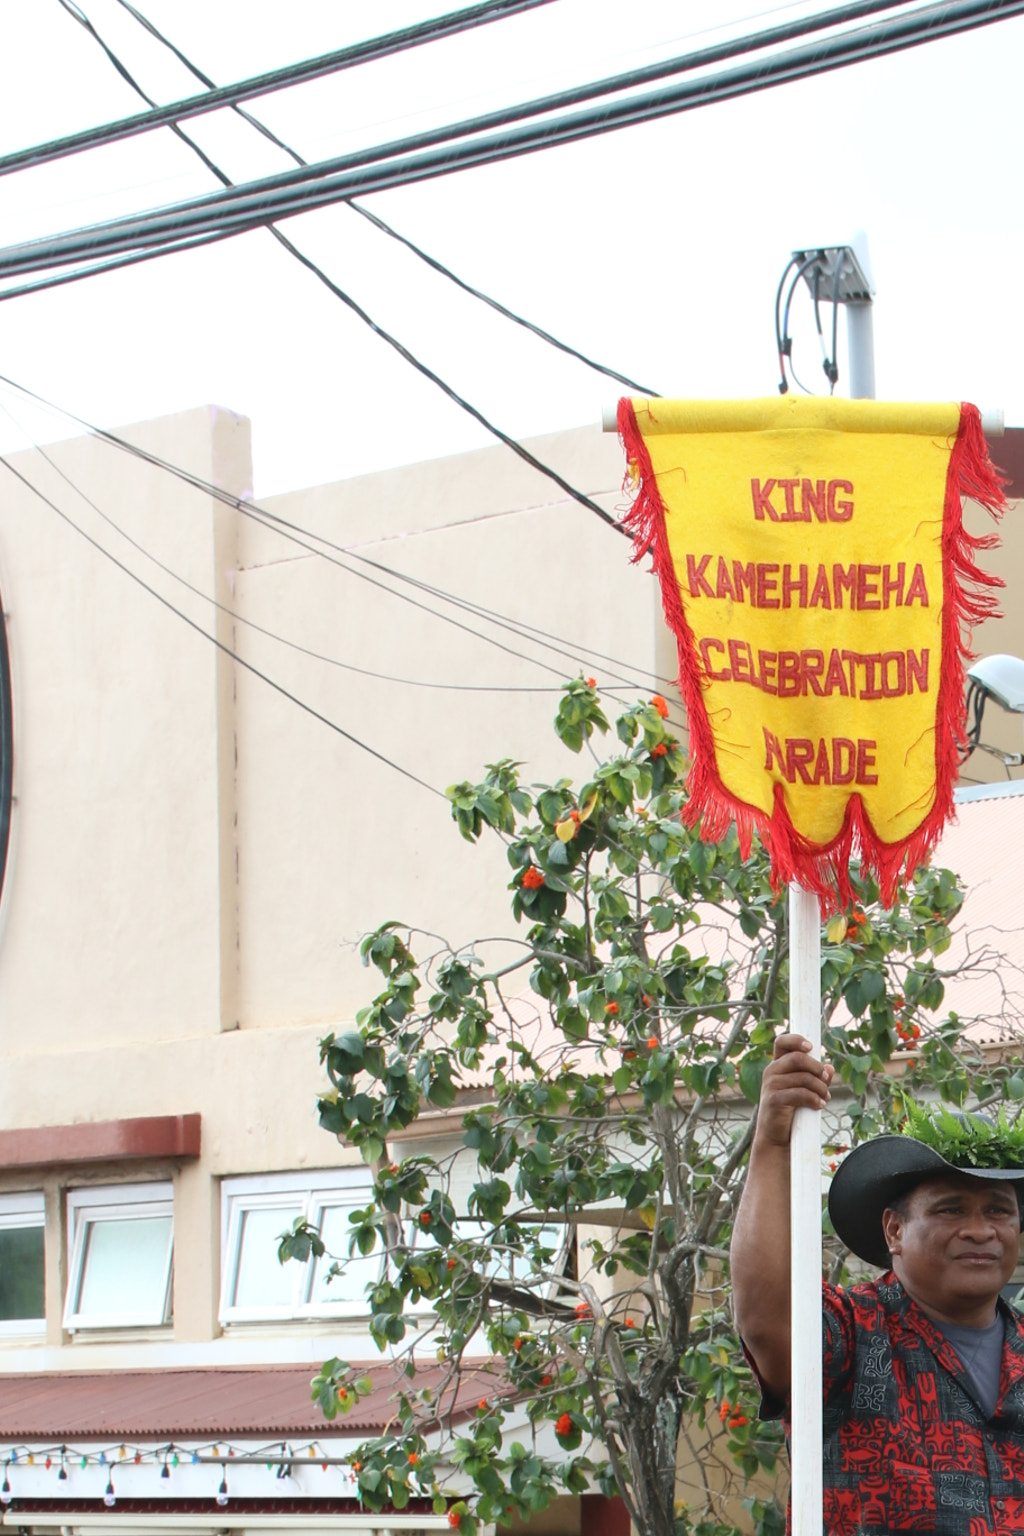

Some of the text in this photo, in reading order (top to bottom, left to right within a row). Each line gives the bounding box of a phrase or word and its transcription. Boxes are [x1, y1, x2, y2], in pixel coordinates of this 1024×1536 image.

[751, 478, 854, 523] KING
[686, 554, 929, 611] KAMEHAMEHA
[699, 637, 930, 701] CELEBRATION
